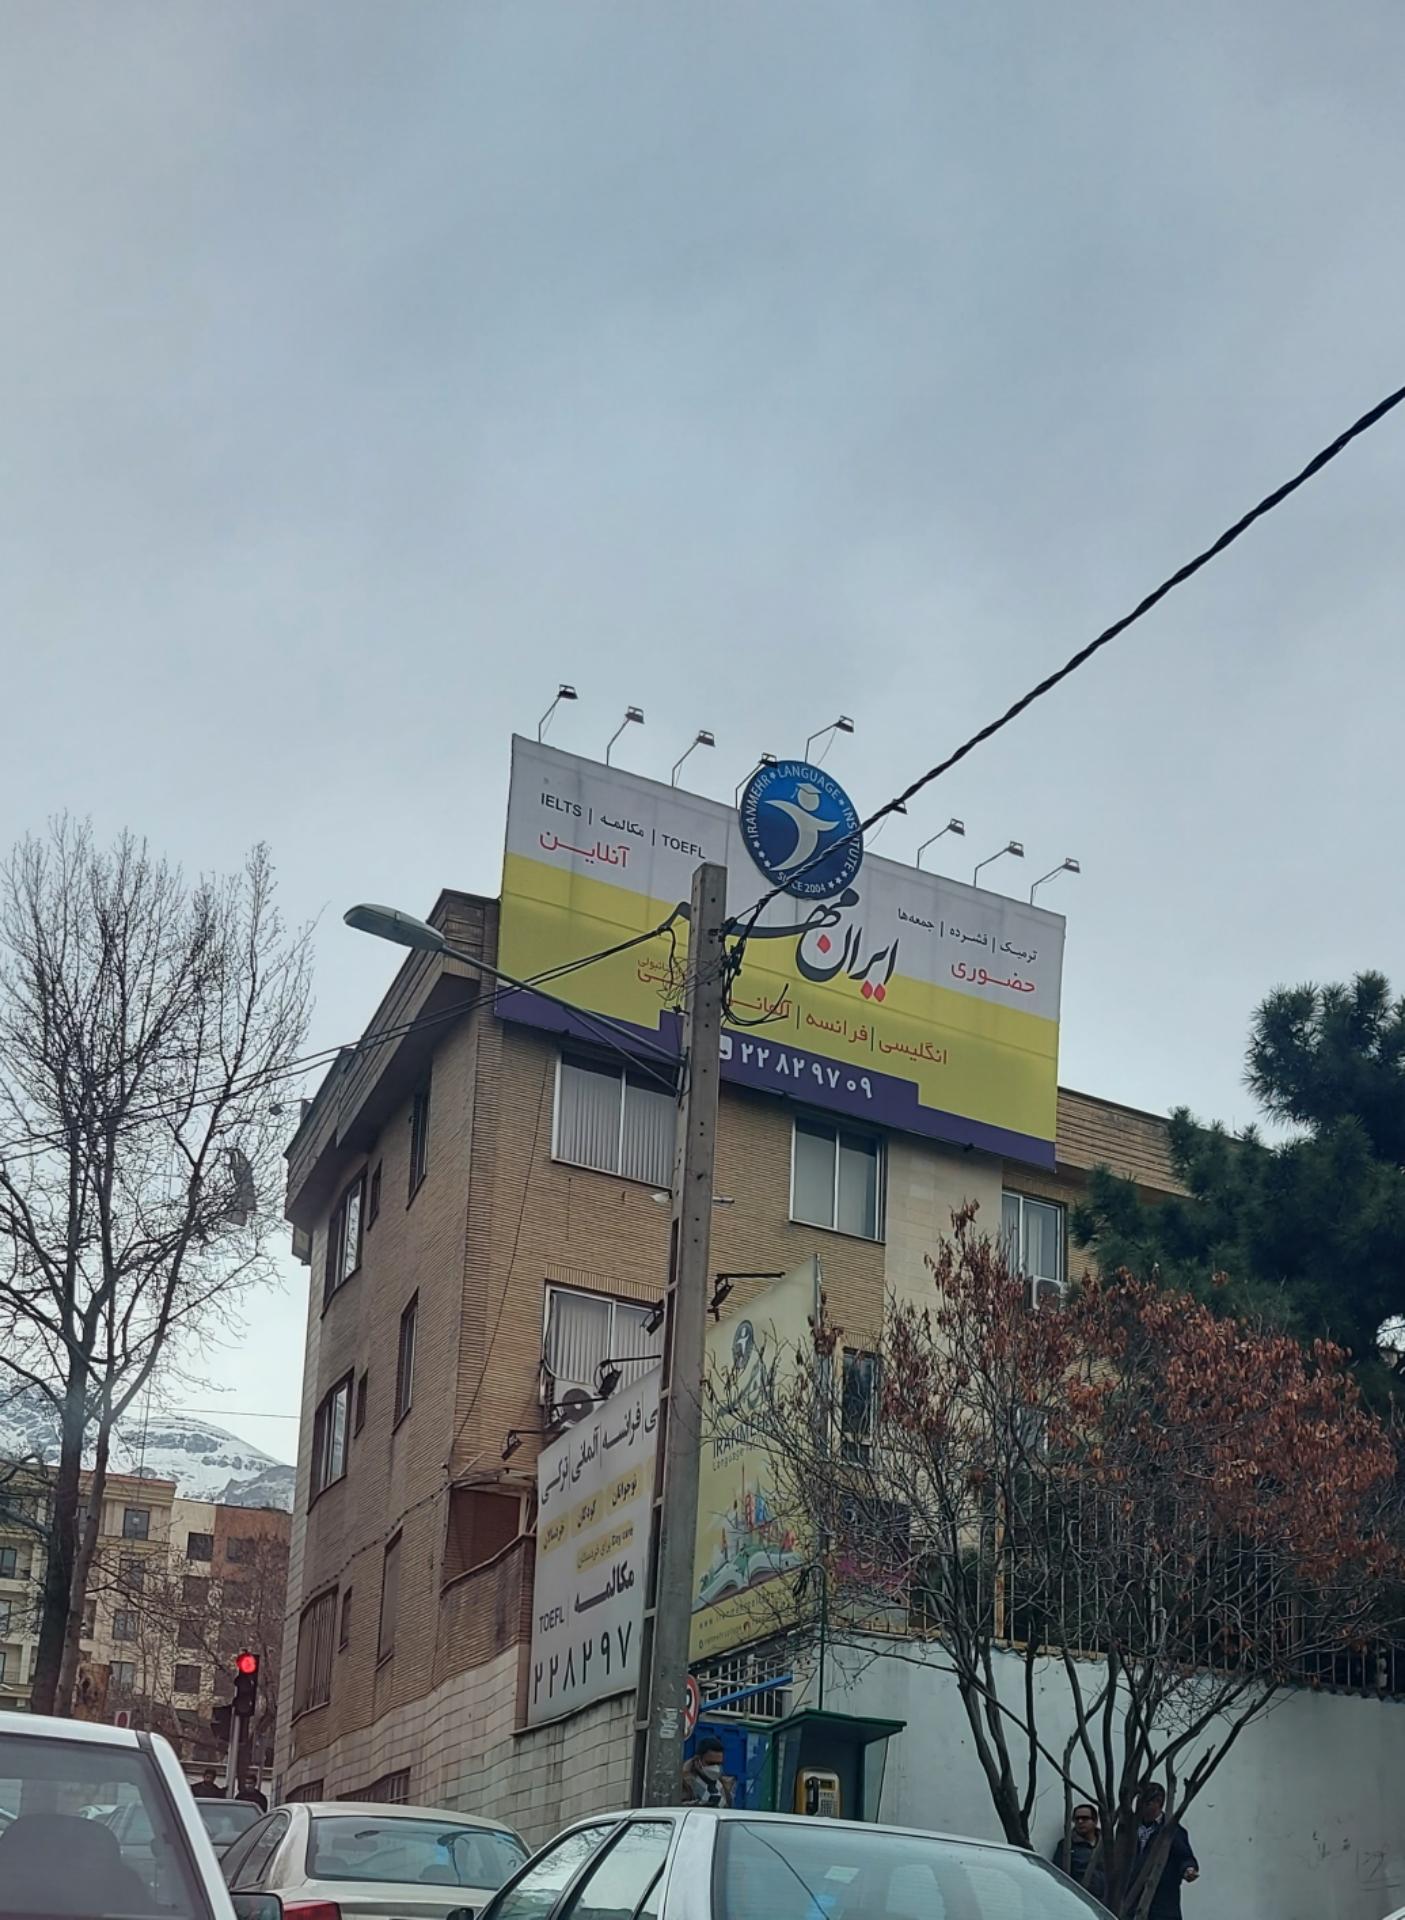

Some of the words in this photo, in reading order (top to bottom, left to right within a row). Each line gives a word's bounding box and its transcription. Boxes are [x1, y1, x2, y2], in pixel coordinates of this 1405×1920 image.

[541, 792, 583, 817] IELTS
[745, 774, 772, 839] IRANMEHR
[777, 765, 841, 800] LANGUAGE
[600, 815, 645, 838] مکالمه
[539, 830, 631, 868] آنلاین
[661, 833, 707, 860] TOEFL
[777, 871, 803, 892] SICE
[804, 883, 826, 893] 2004
[796, 923, 899, 1003] ایران
[951, 962, 1036, 993] حضوری
[805, 1012, 868, 1043] فرانسه
[878, 1039, 948, 1065] انگلیسی
[541, 1455, 569, 1506] ترکی
[574, 1560, 635, 1613] مکالمه
[539, 1606, 565, 1634] TOEFL
[533, 1620, 641, 1705] ۲۲۸۲۹۷
